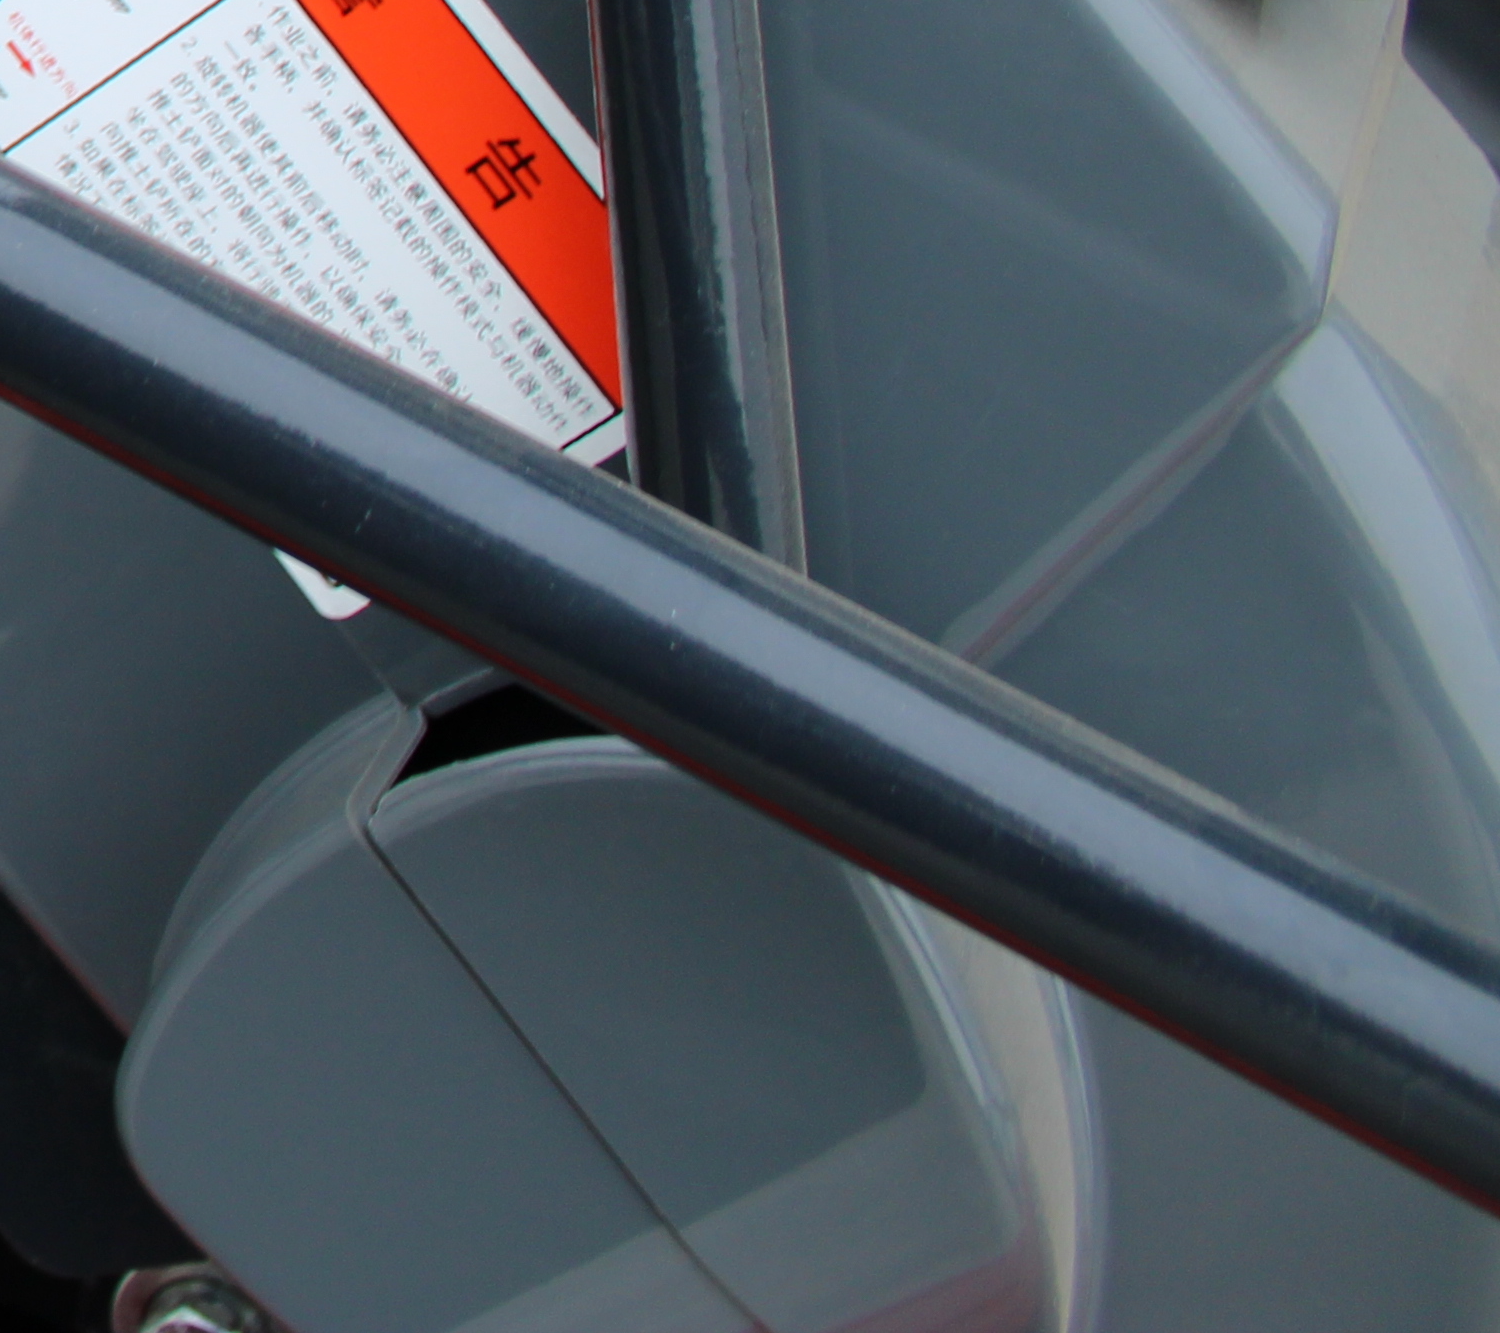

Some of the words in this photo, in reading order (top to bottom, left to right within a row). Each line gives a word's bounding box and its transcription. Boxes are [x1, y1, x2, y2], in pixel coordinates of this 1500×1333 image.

[4, 8, 81, 101] 机体行进方向
